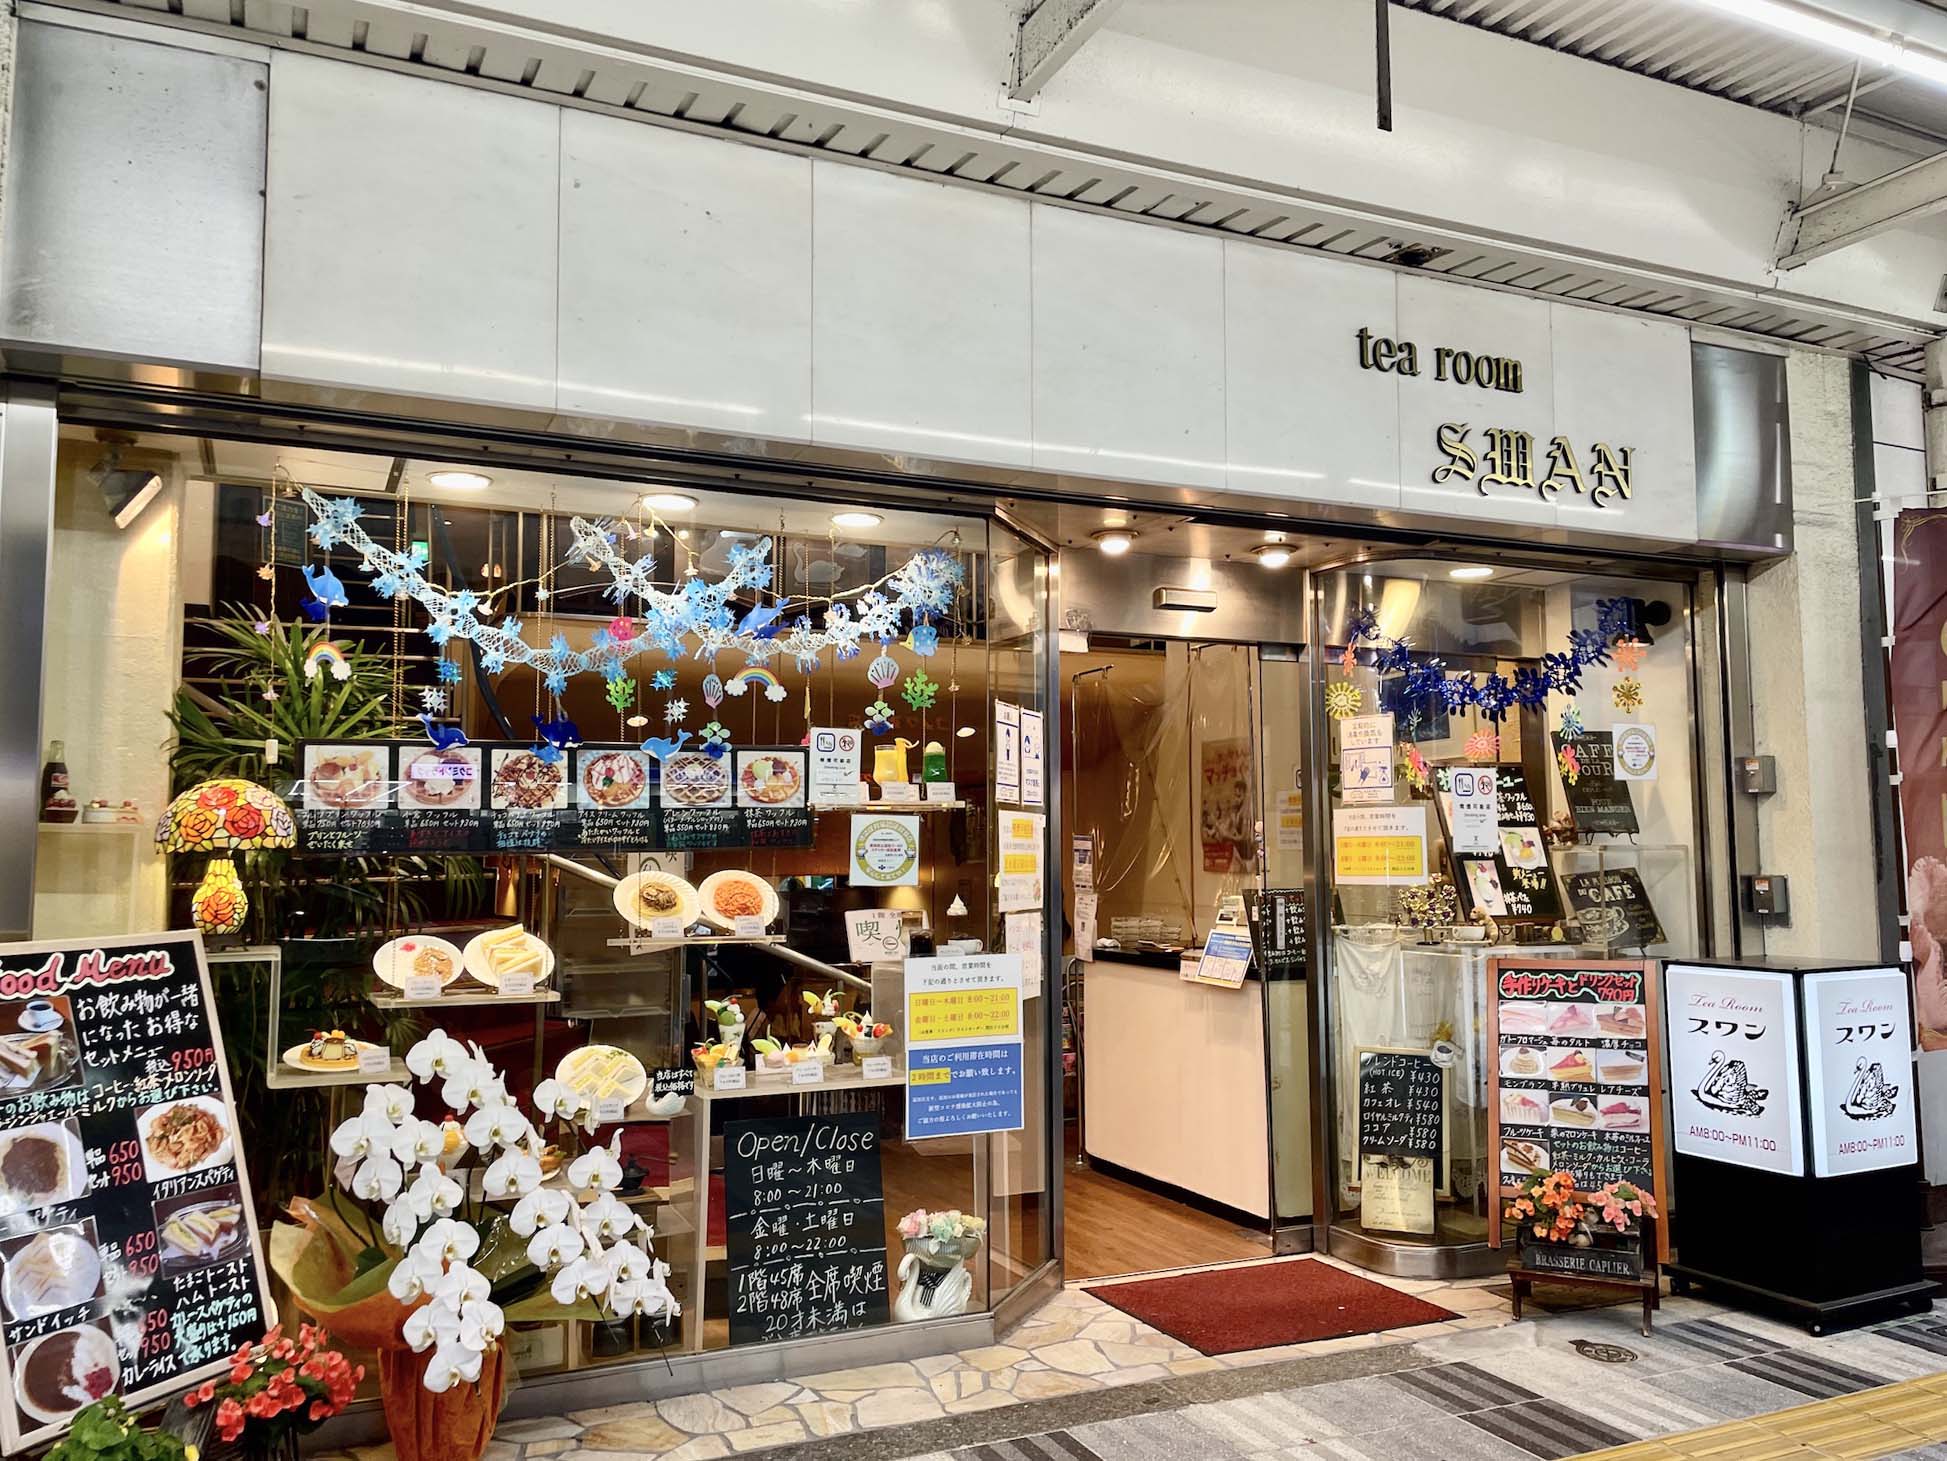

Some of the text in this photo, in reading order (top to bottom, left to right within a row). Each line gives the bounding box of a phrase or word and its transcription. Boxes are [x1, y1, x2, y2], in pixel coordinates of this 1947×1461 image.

[1355, 326, 1524, 393] tea room
[1432, 422, 1636, 508] SWAN
[1578, 761, 1614, 776] OUR
[0, 950, 173, 996] ood Menu
[1502, 973, 1638, 996] 手作りケーキと ドリンクセット
[1598, 989, 1636, 1002] 790円
[1719, 996, 1763, 1013] Room
[1688, 1017, 1767, 1040] スワン
[1835, 1022, 1896, 1045] スワン
[83, 1046, 164, 1068] セットメニュー
[1410, 1070, 1440, 1084] ¥430
[1363, 1081, 1439, 1097] 紅茶 ¥430
[0, 1089, 90, 1114] のお飲み物は
[1407, 1098, 1439, 1111] ¥540
[1363, 1123, 1437, 1139] ココア ¥580
[1416, 1113, 1440, 1126] ¥580
[108, 1139, 140, 1165] 650
[1408, 1138, 1437, 1149] ¥580
[111, 1162, 143, 1187] 950
[125, 1230, 156, 1256] 650
[128, 1254, 159, 1277] 950
[1535, 1253, 1585, 1270] BRASSERIE
[141, 1331, 171, 1360] 950
